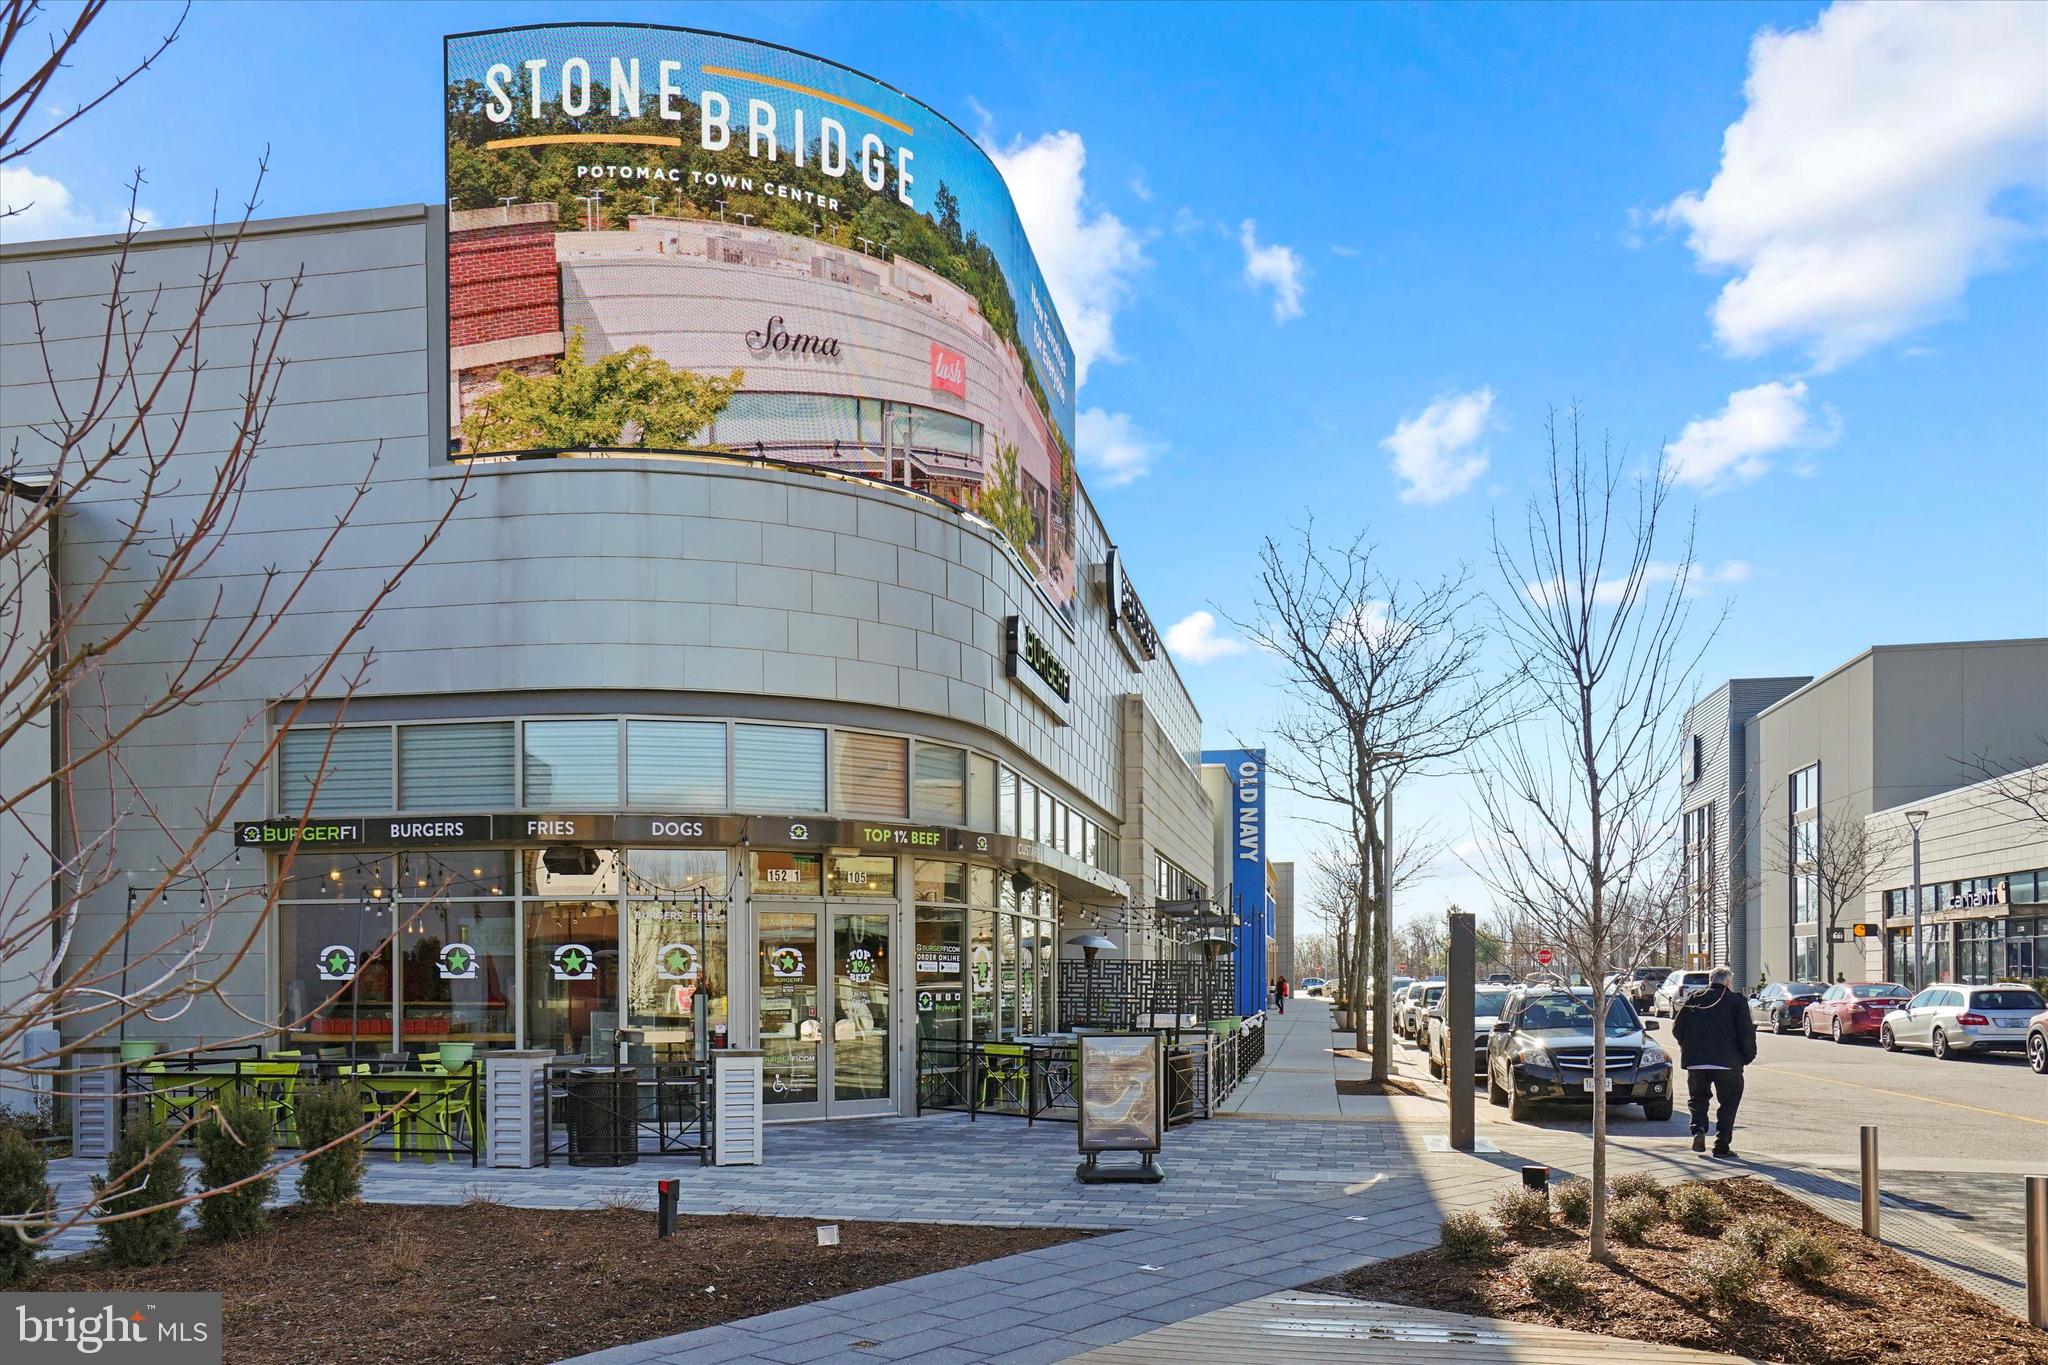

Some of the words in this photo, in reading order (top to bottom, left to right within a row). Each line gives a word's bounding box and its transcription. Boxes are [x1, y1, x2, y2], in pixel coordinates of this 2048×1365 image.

[486, 57, 681, 122] STONE
[701, 91, 913, 210] BRIDGE
[578, 165, 680, 181] POTOMAC
[692, 171, 752, 191] TOWN
[764, 182, 839, 211] CENTER
[745, 315, 841, 357] Soma
[936, 352, 963, 384] lush
[1239, 762, 1258, 803] OLD
[263, 826, 357, 841] BURGERFI
[390, 822, 464, 838] BURGERS
[527, 821, 575, 835] FRIES
[652, 822, 703, 836] DOGS
[1239, 807, 1259, 863] NAVY
[864, 828, 892, 842] TOP
[893, 830, 908, 844] 1%
[911, 831, 940, 846] BEEF
[848, 872, 866, 883] 105
[634, 911, 683, 920] BURGERS
[691, 911, 719, 921] FRIES
[849, 948, 871, 960] TOP
[917, 953, 937, 961] ORDER
[938, 954, 960, 962] ONLINE
[851, 960, 870, 974] 1%
[849, 972, 871, 983] BEEF
